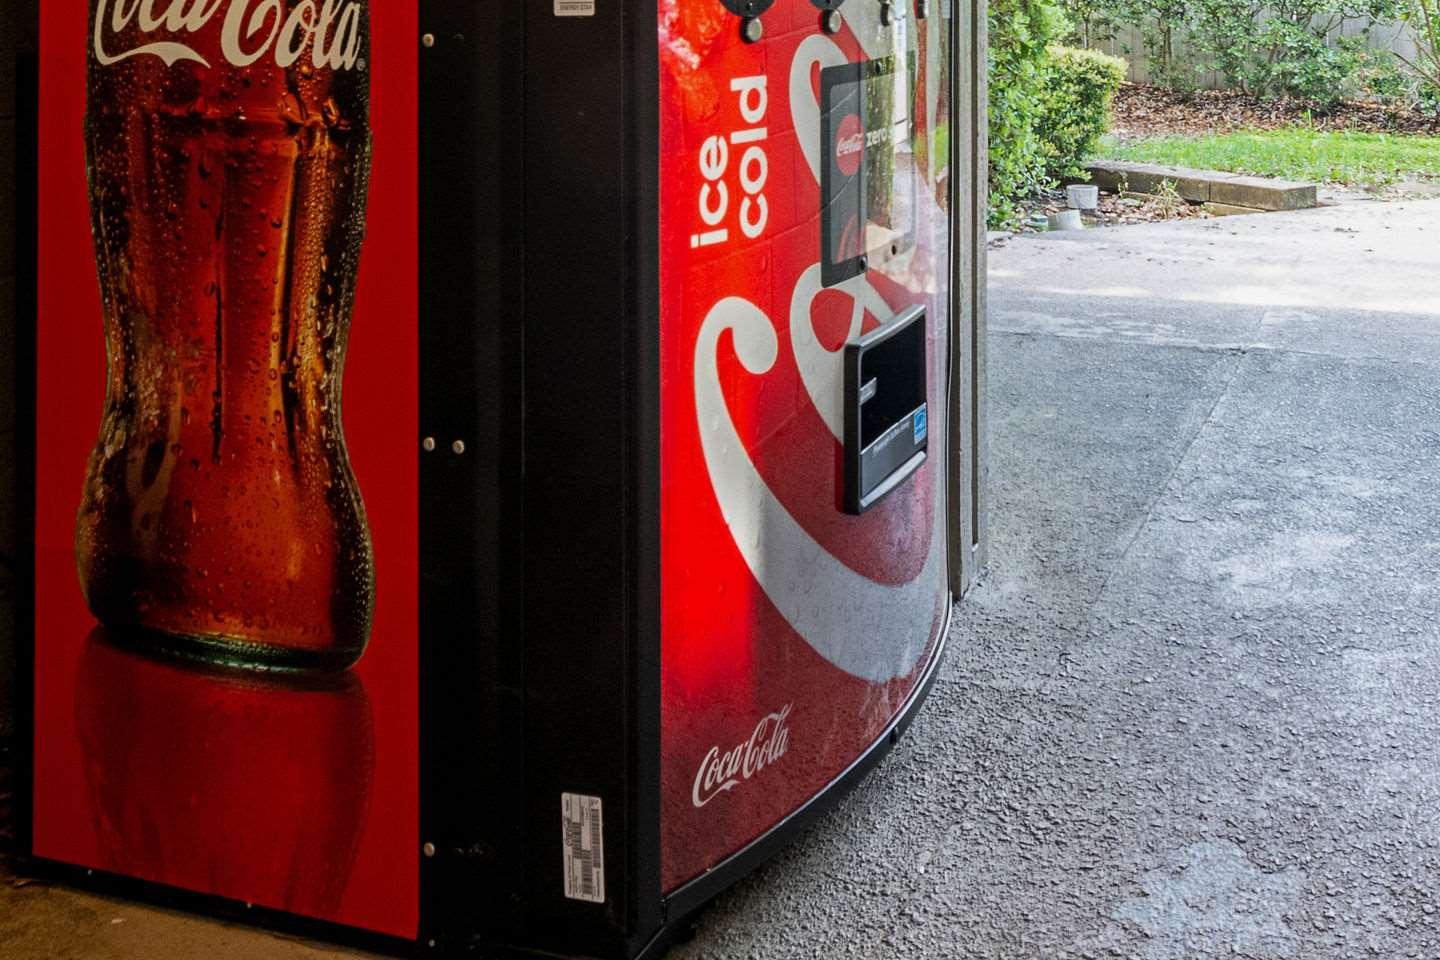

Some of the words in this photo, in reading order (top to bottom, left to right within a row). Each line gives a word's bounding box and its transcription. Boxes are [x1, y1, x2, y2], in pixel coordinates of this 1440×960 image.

[690, 135, 729, 248] ice
[730, 74, 768, 238] cold
[865, 127, 888, 147] zero
[692, 703, 793, 808] Coca-Cola
